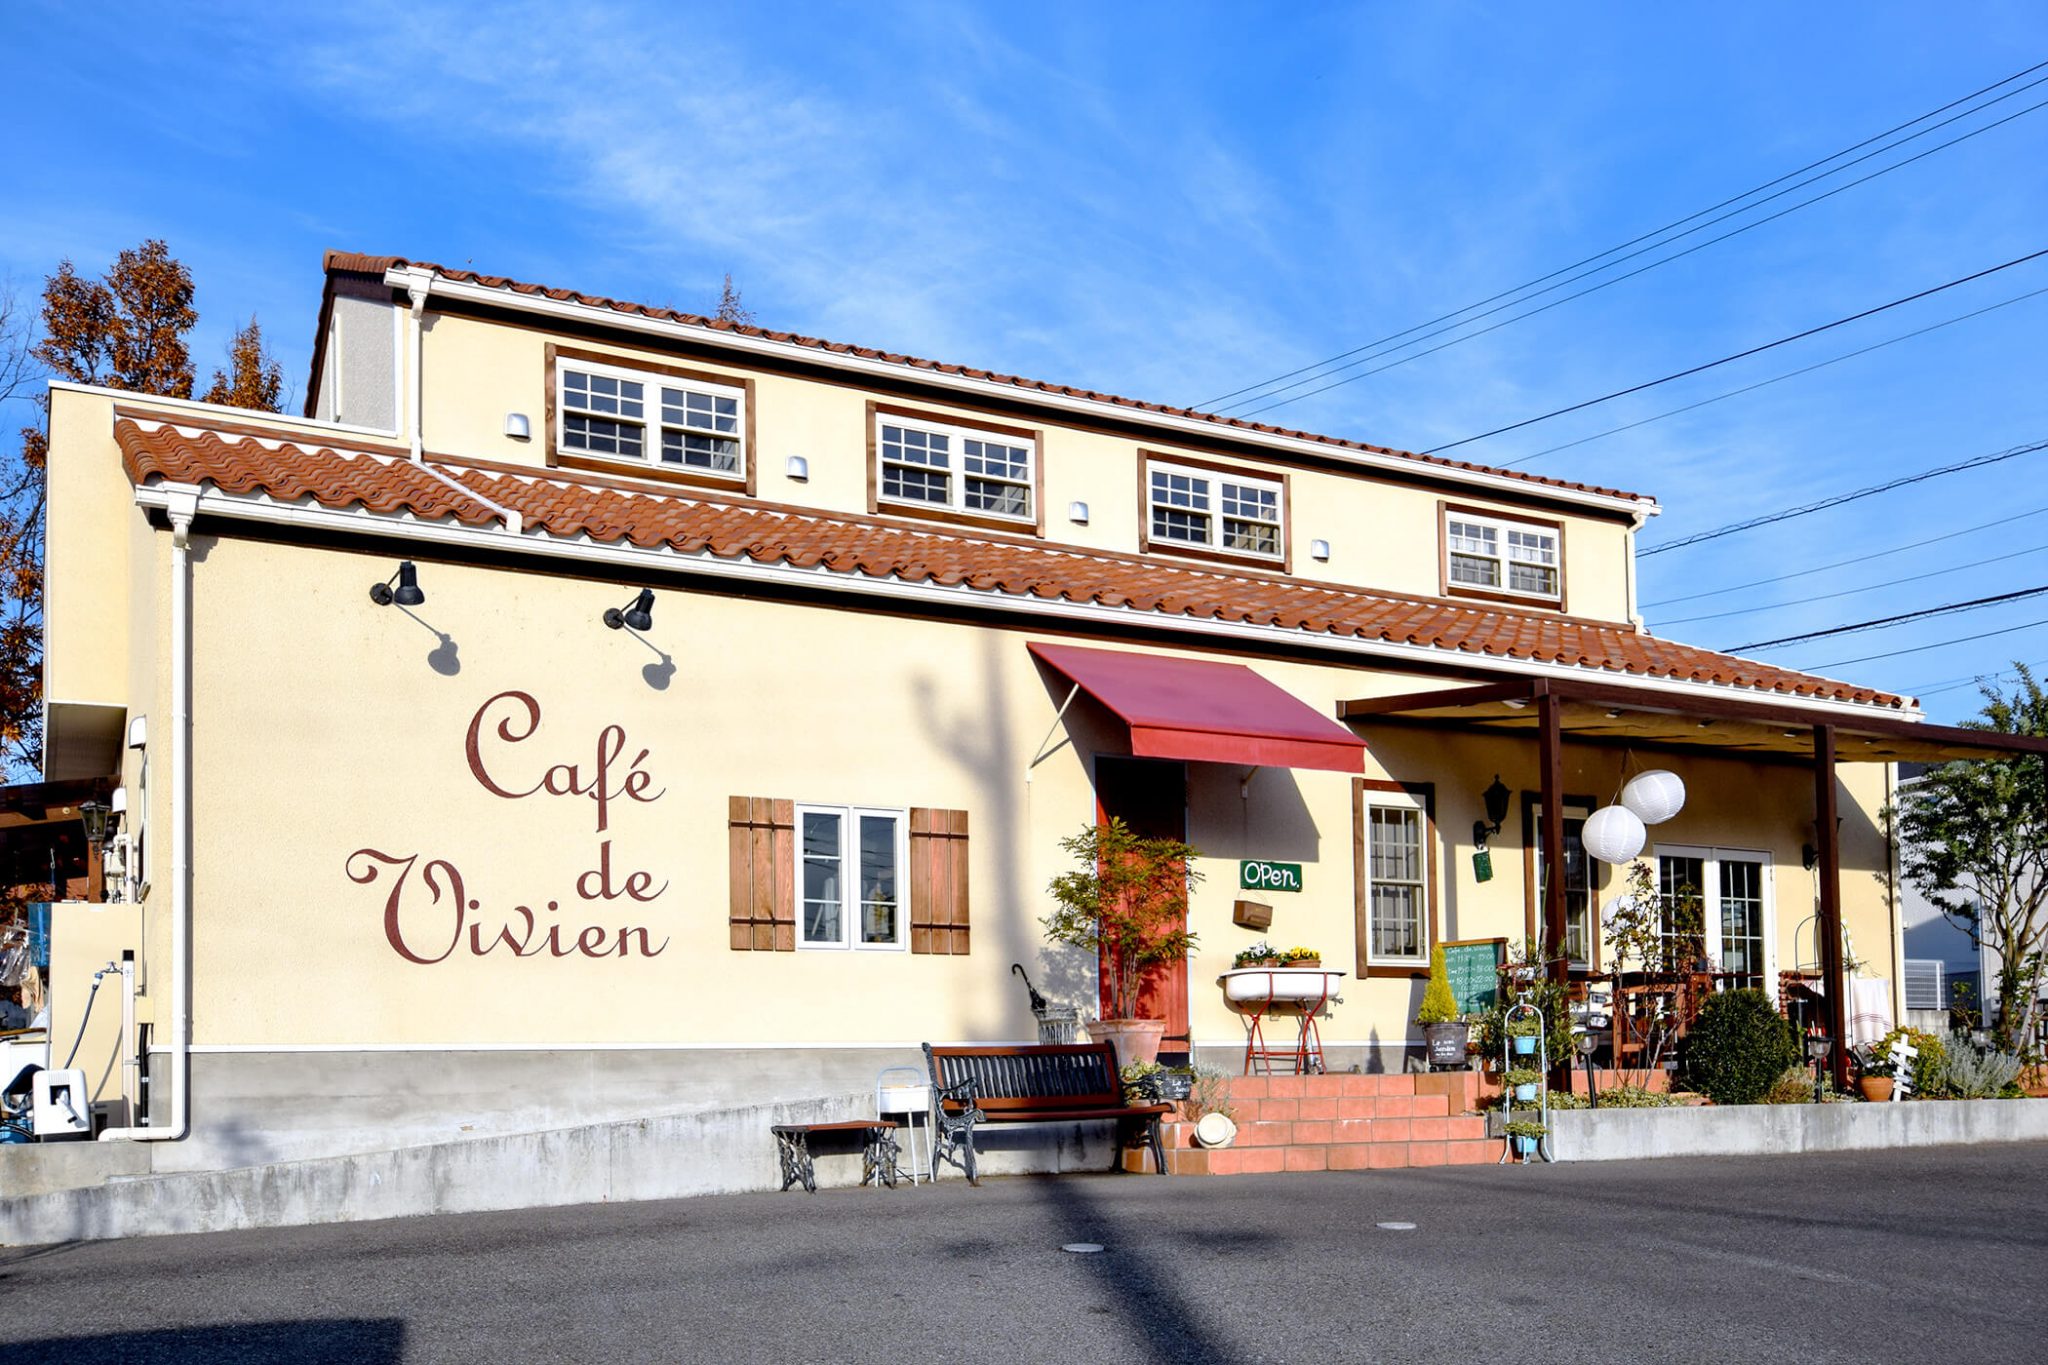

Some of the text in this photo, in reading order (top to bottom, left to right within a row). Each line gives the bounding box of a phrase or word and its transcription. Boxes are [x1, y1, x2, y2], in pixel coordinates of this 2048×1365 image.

[465, 690, 666, 833] Café
[345, 848, 670, 965] Vivien
[576, 839, 669, 902] de
